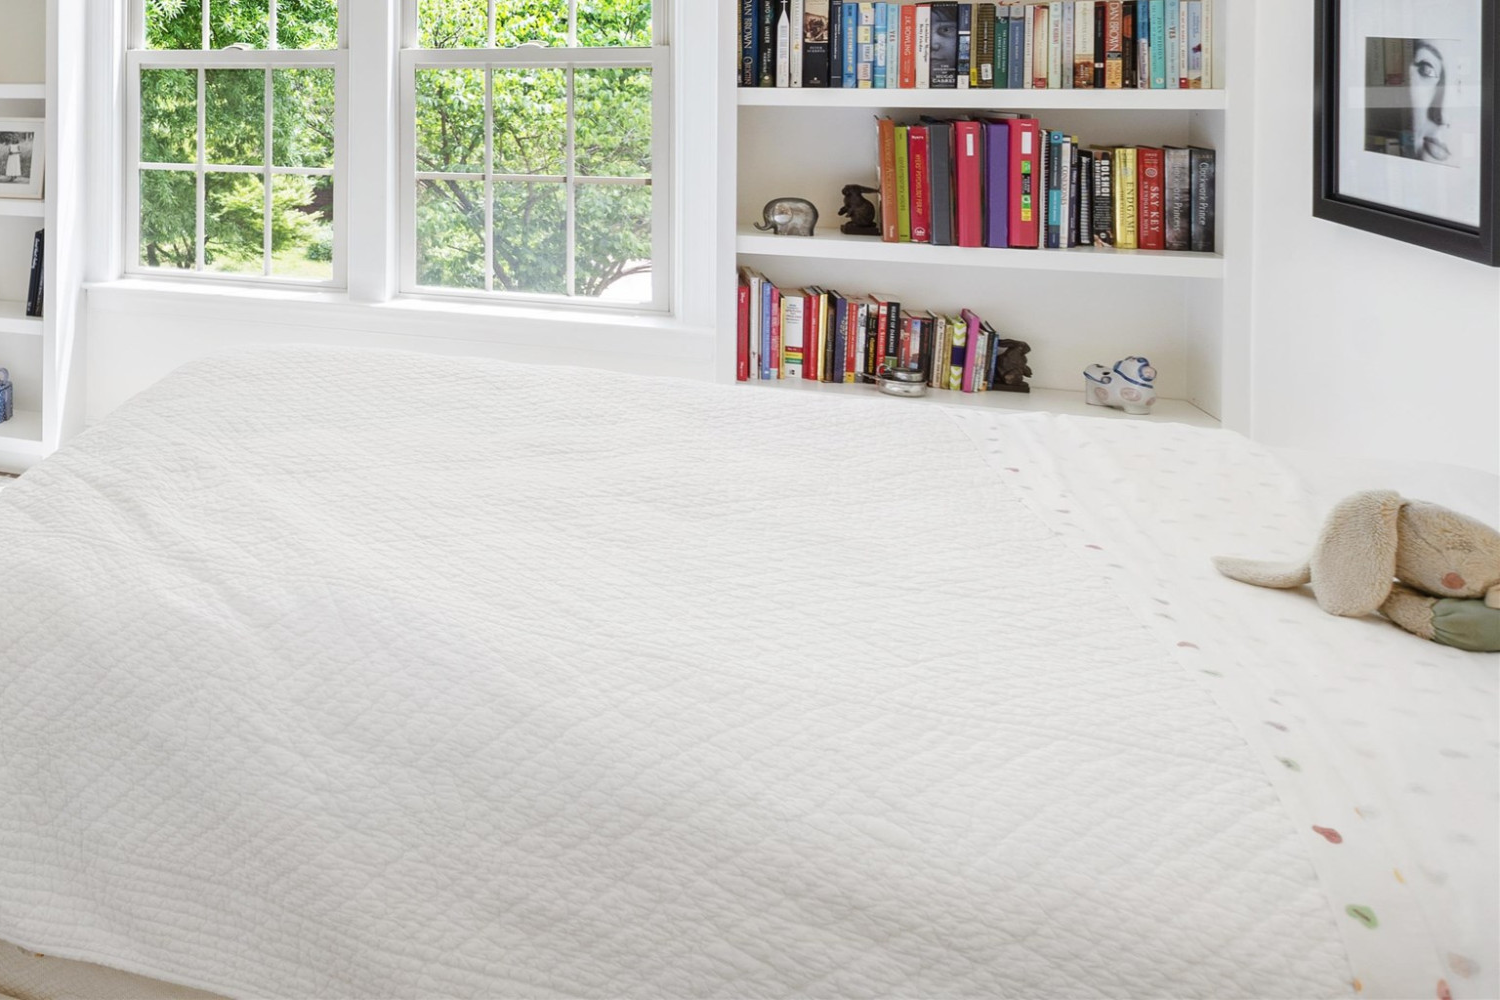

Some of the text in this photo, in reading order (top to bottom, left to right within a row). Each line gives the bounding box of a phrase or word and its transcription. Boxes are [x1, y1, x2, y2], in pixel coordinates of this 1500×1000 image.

[744, 18, 753, 49] BROWN
[1109, 2, 1119, 51] DAN BROWN
[1101, 160, 1110, 197] BOLSHOI
[1198, 162, 1209, 226] Clockwork Prince
[1126, 182, 1135, 235] ENDGAME
[1150, 186, 1159, 232] SKY KEY
[1173, 202, 1182, 232] Princess
